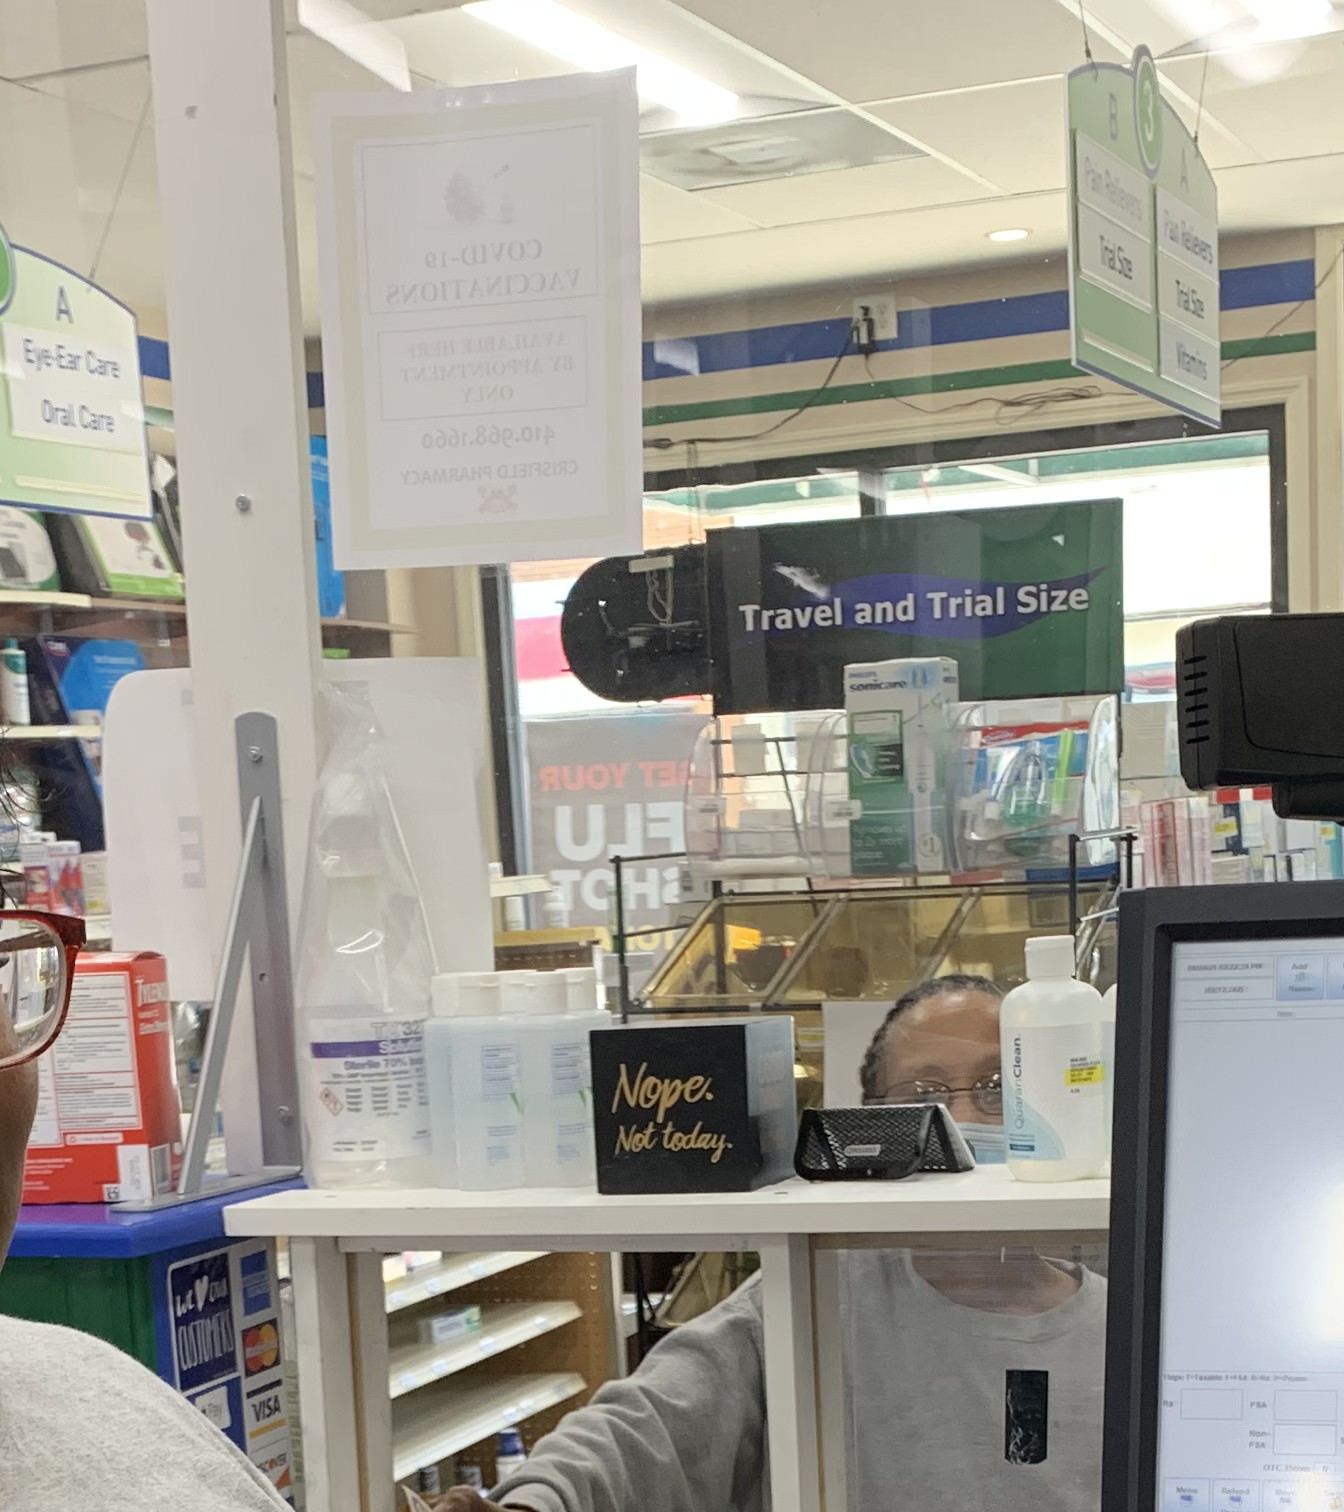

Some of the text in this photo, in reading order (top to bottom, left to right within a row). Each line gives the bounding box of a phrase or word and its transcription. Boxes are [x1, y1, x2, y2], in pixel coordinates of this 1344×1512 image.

[1109, 92, 1118, 141] B
[1143, 79, 1155, 142] 3
[1180, 147, 1189, 193] A
[1100, 234, 1133, 281] Trial Size
[56, 285, 73, 324] A
[1176, 279, 1204, 319] Trial Size
[23, 338, 120, 379] Eye-Ear Care
[41, 399, 115, 433] Oral Care
[739, 583, 1089, 632] Travel and Trial Size
[612, 1062, 714, 1124] Nope.
[615, 1119, 734, 1164] Not today.
[251, 1394, 281, 1423] VISA
